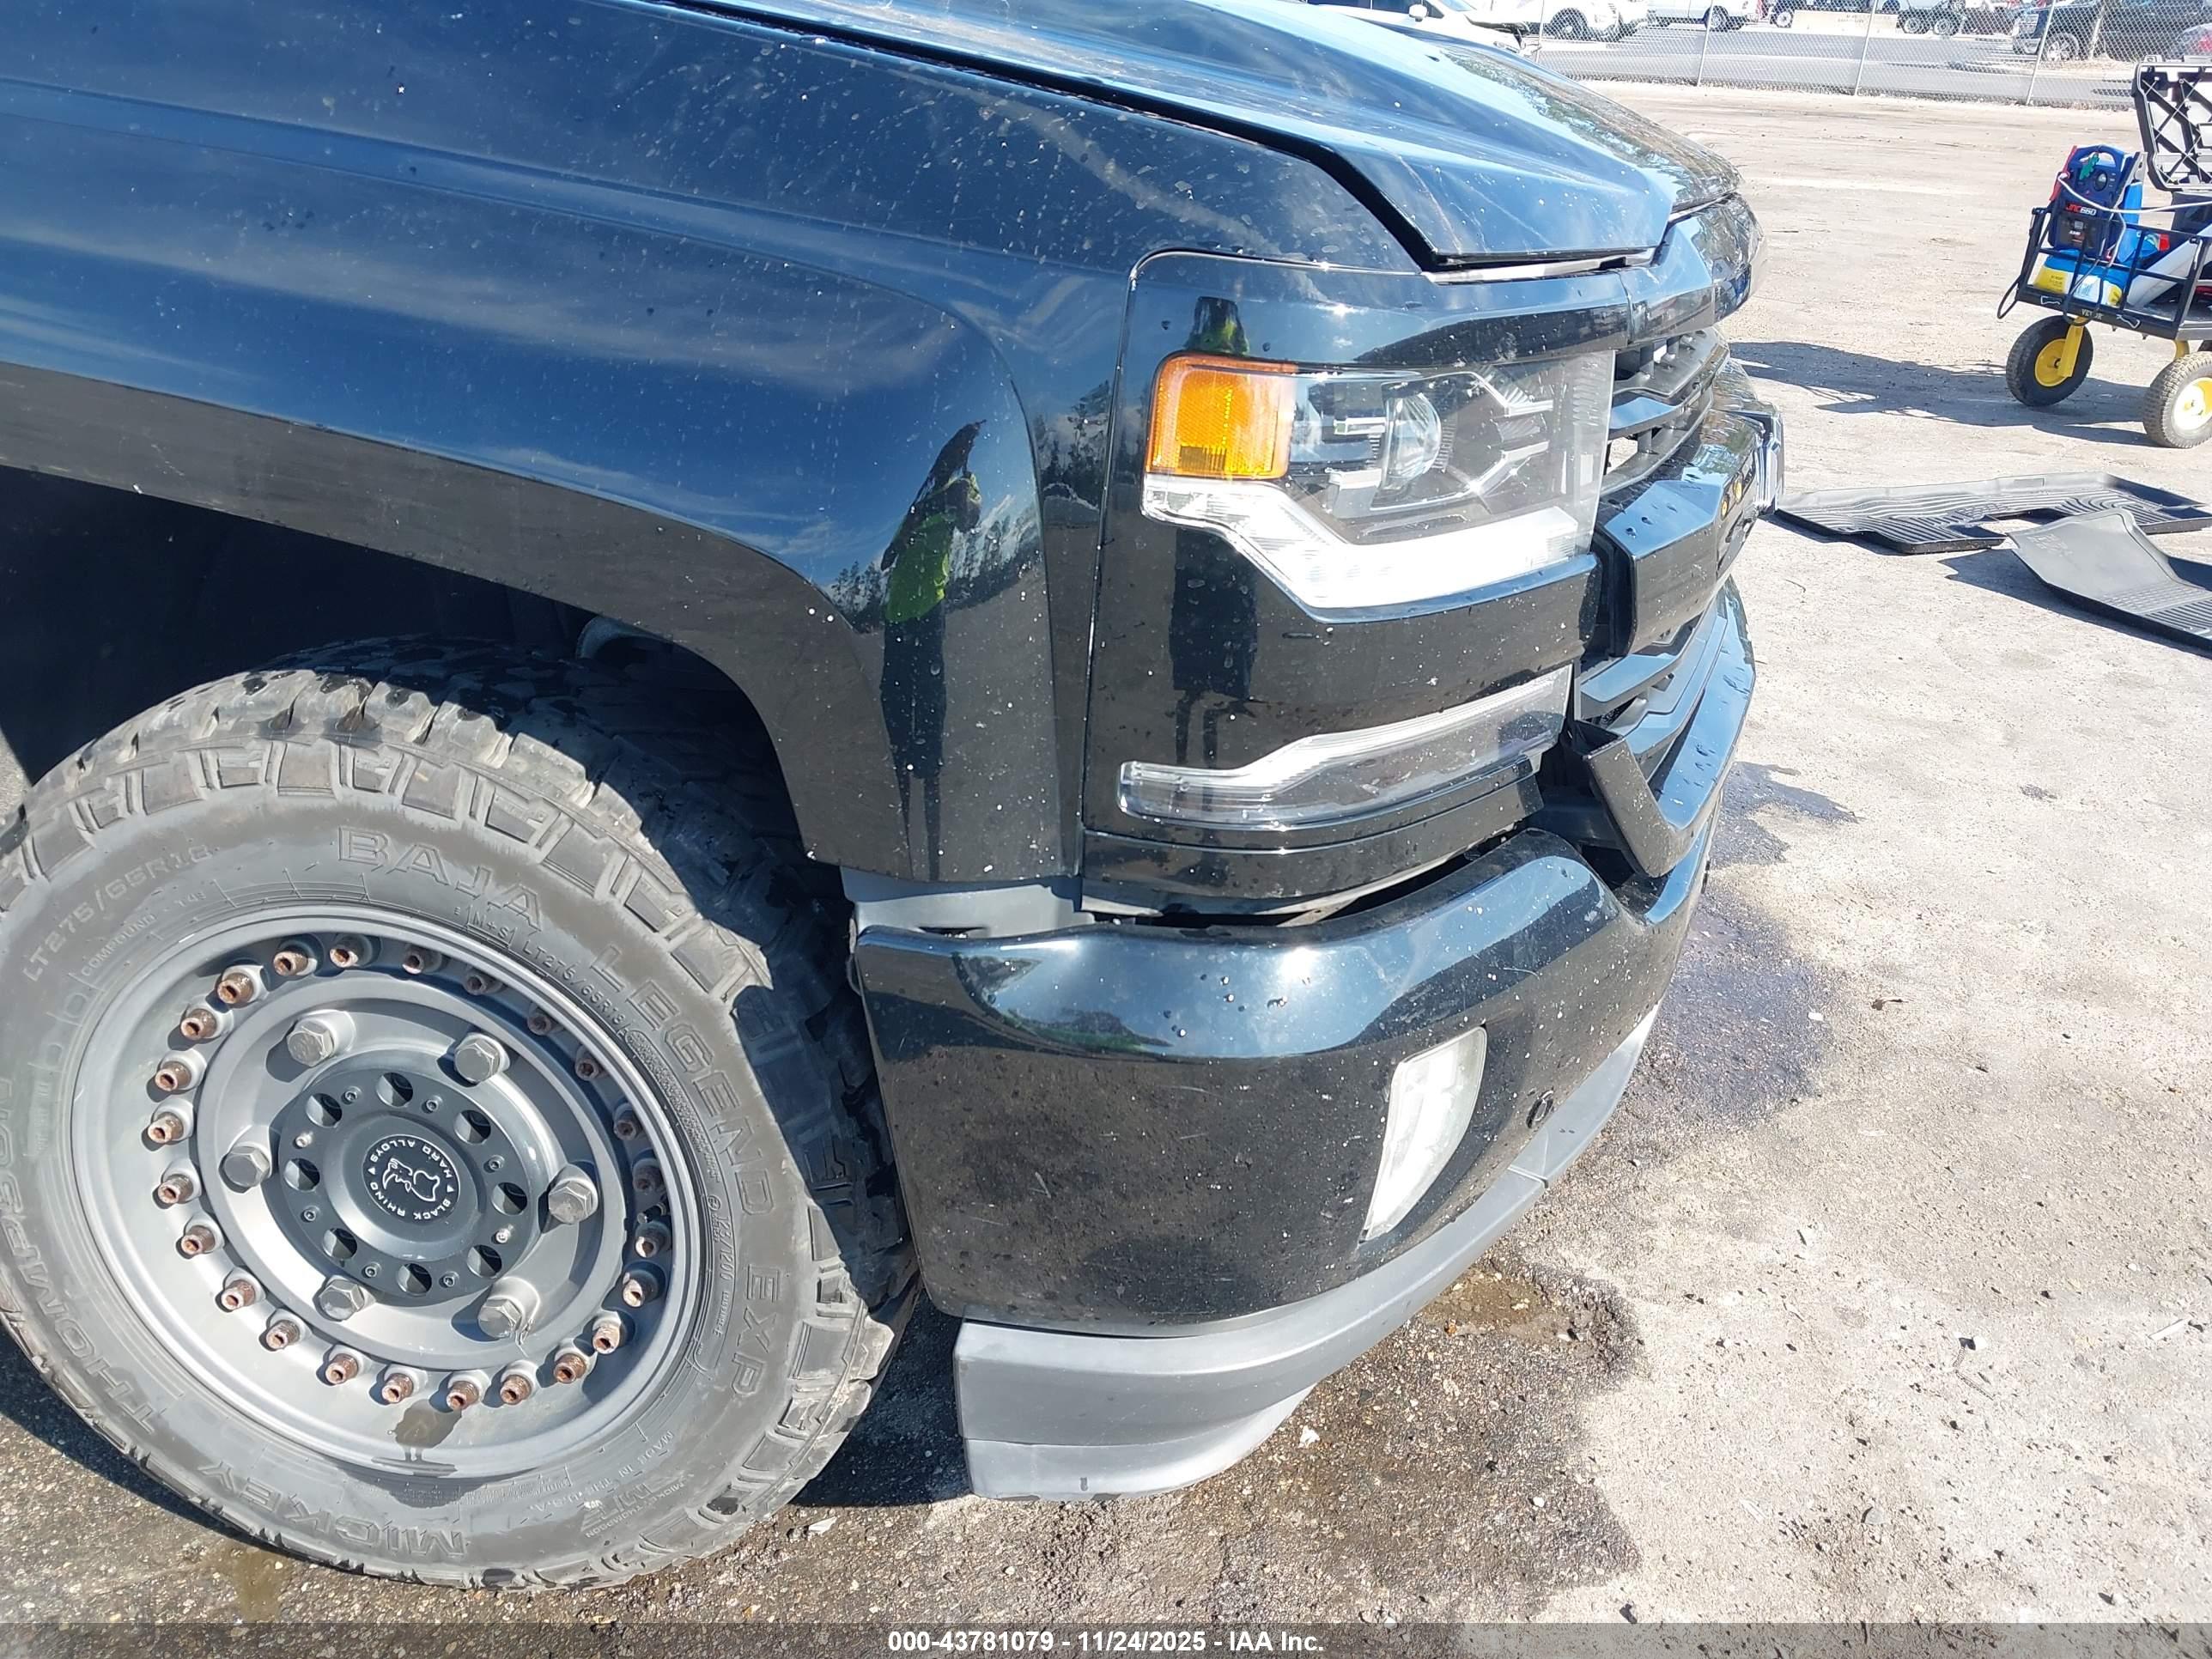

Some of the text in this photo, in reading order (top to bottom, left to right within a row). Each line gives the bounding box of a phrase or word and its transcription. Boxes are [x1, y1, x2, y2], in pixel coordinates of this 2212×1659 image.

[81, 913, 158, 976] COMPOUND
[338, 825, 542, 937] BAJA
[590, 944, 774, 1216] LEGEND
[730, 1263, 781, 1395] EXP
[370, 1139, 453, 1178] HARD ALLOYS
[370, 1182, 452, 1220] BLACK RHINO
[0, 1078, 470, 1558] MICKEY THOMPS
